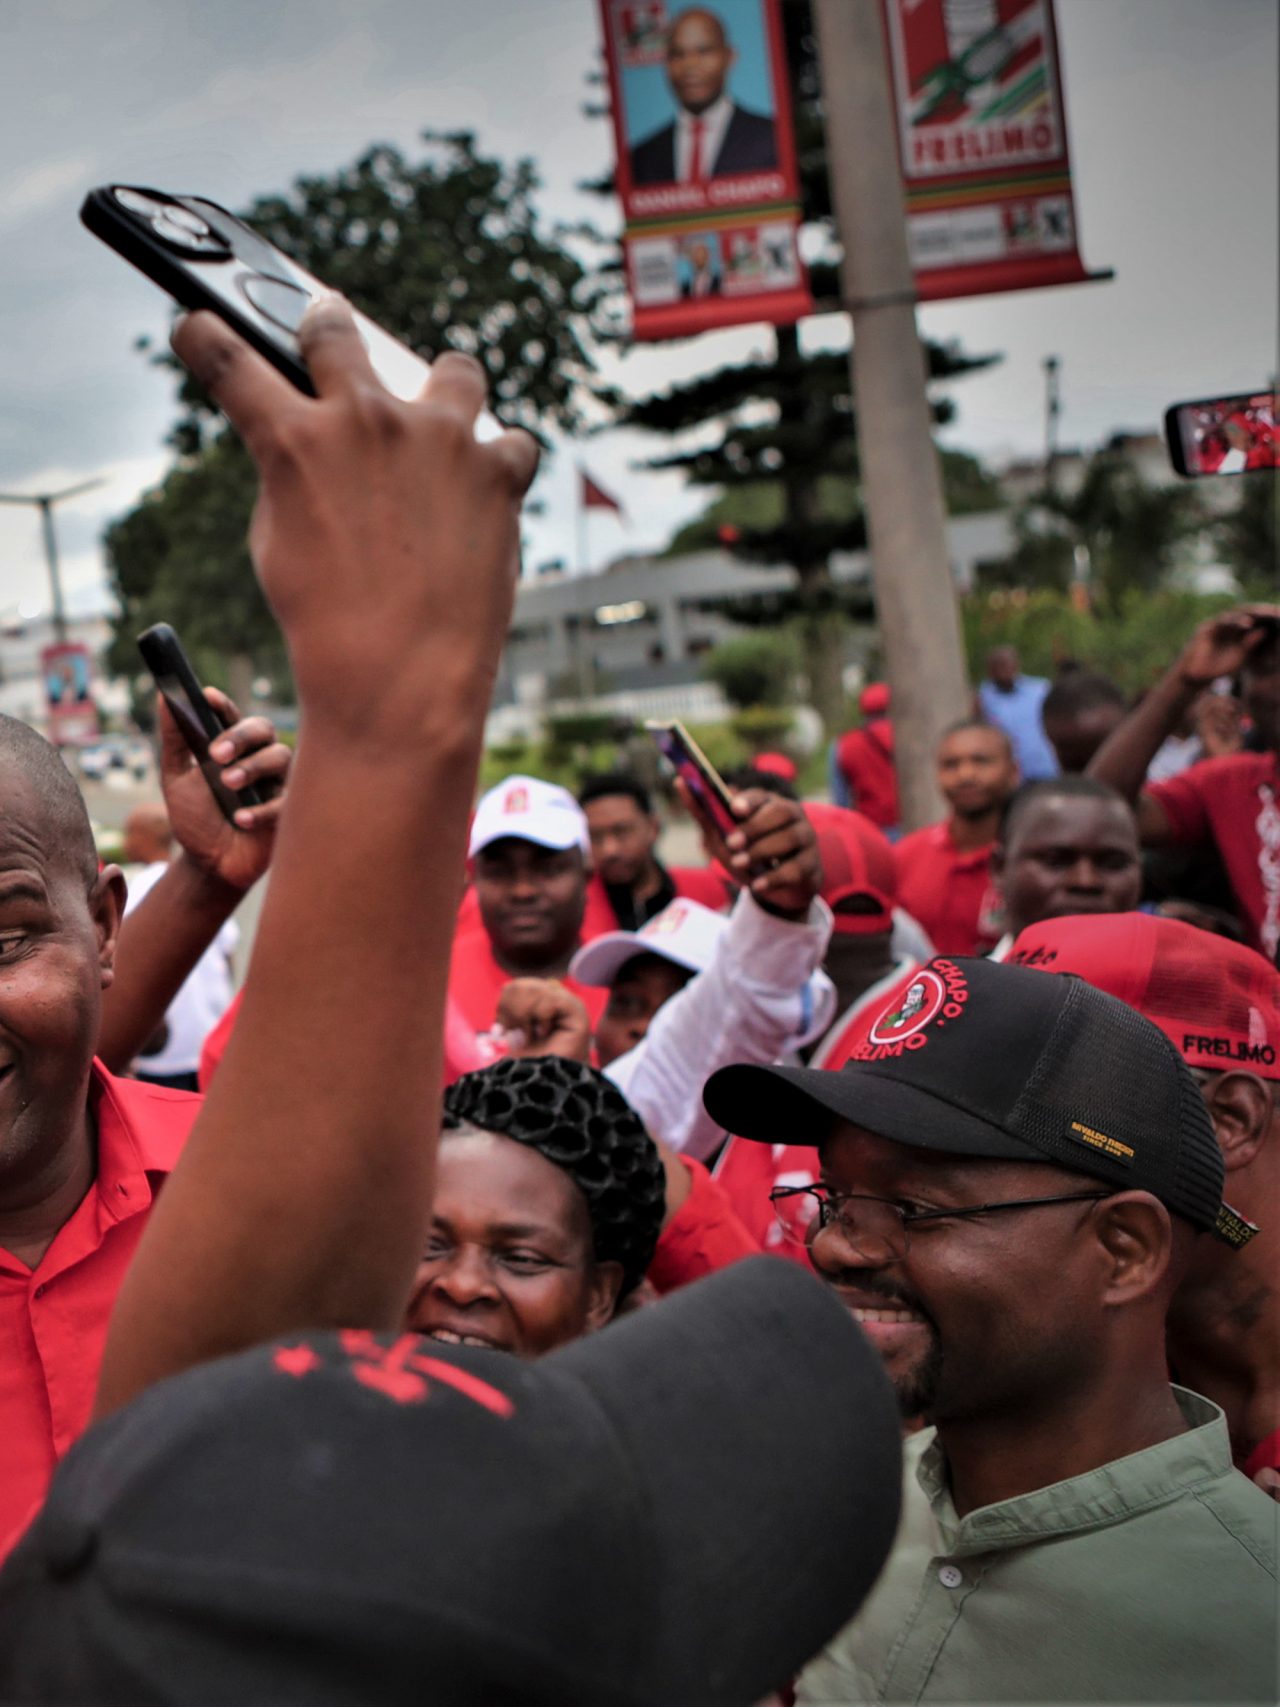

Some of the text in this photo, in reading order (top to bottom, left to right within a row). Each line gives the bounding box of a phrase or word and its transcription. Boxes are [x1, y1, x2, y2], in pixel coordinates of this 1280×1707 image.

[913, 124, 1053, 166] FRELIMO
[932, 959, 969, 1018] CHAPO
[1183, 1034, 1276, 1066] FRELIMO
